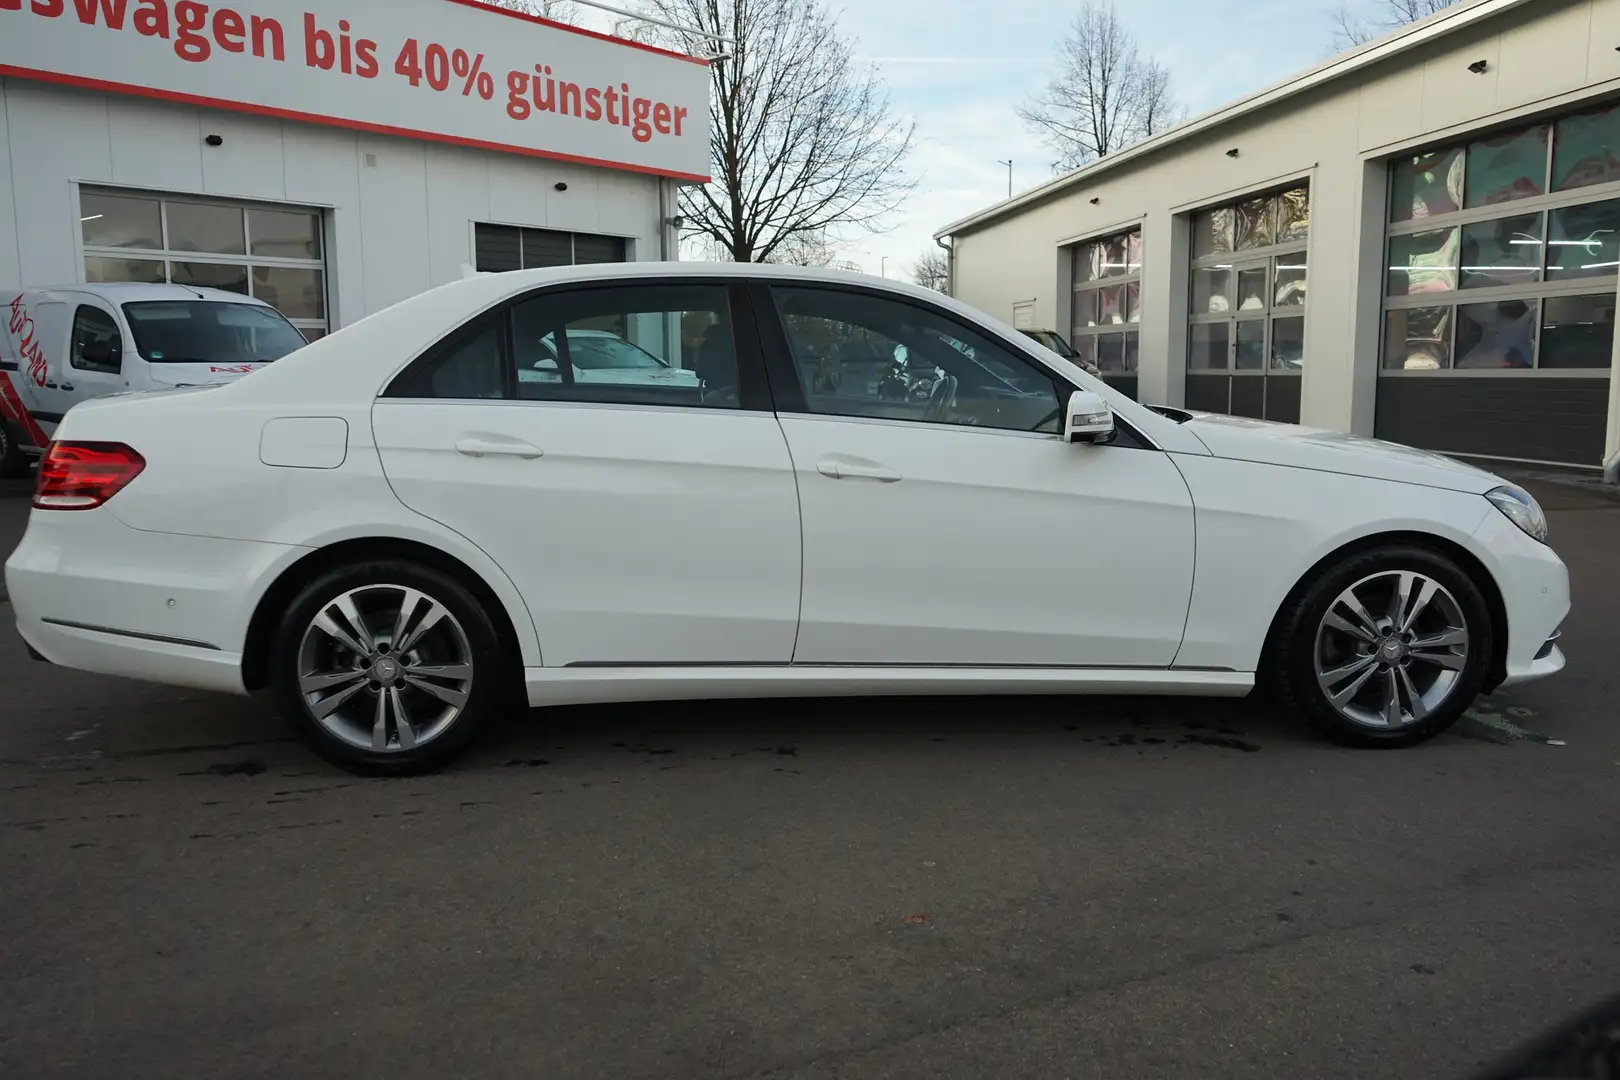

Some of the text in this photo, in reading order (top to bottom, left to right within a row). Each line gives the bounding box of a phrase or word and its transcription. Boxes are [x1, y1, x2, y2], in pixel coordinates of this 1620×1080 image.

[300, 12, 379, 78] bis
[394, 38, 494, 100] 40%
[506, 63, 688, 142] günstiger
